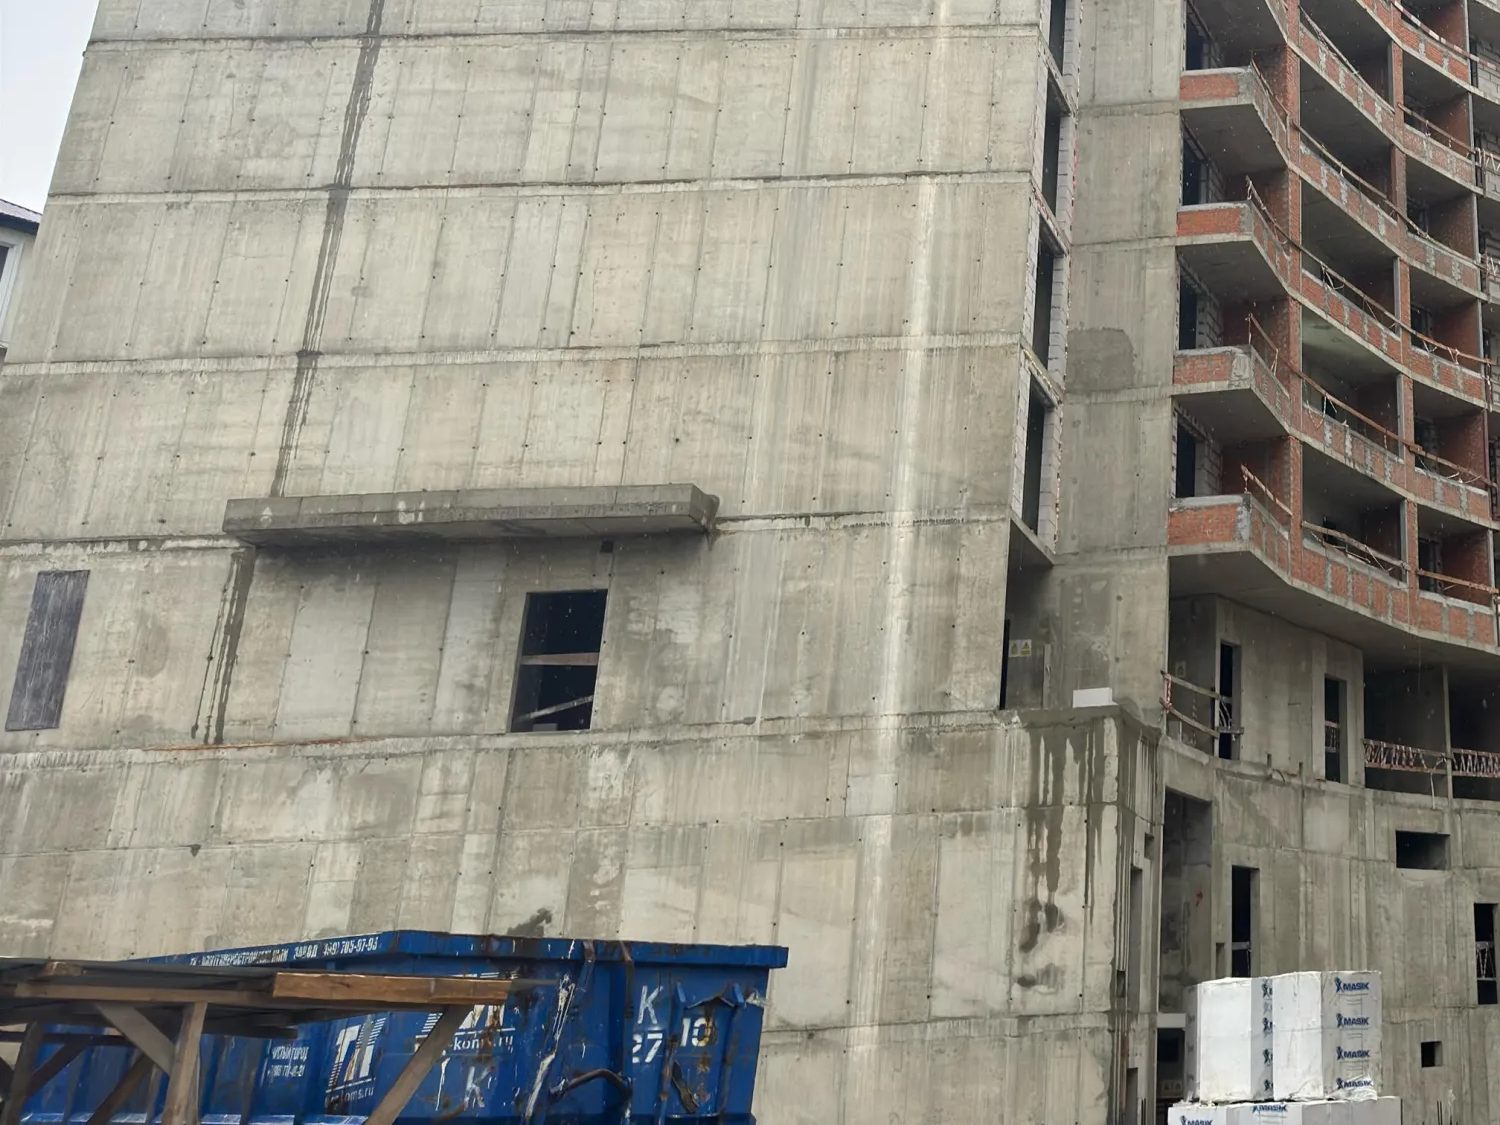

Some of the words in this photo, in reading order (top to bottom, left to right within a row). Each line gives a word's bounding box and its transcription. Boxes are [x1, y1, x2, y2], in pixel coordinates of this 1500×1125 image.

[1342, 981, 1370, 991] MASIK
[1343, 1016, 1370, 1026] MASIK
[1343, 1049, 1370, 1059] MASIK
[1343, 1079, 1373, 1088] MASIK
